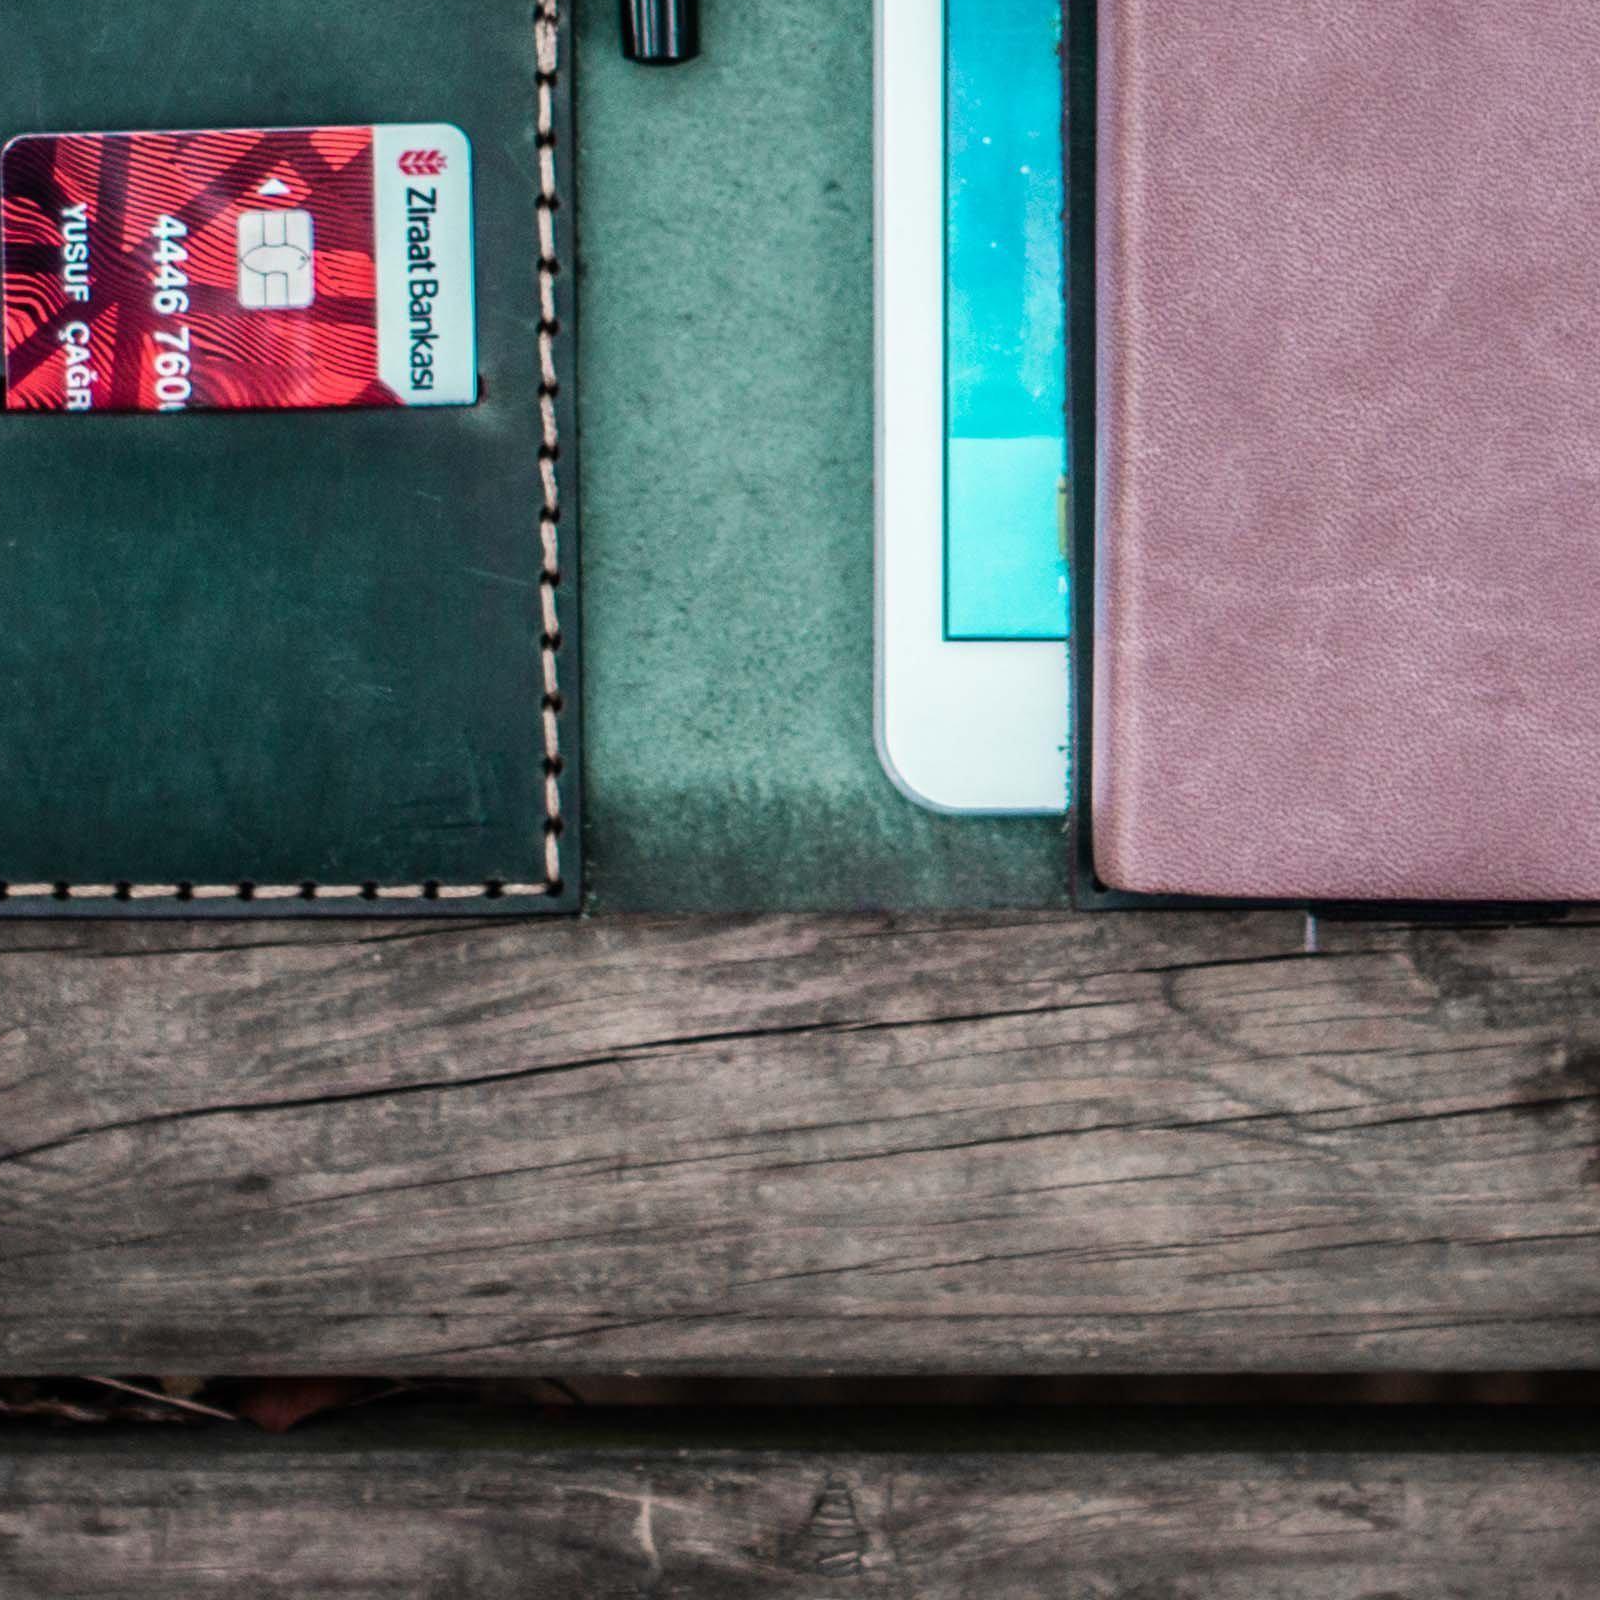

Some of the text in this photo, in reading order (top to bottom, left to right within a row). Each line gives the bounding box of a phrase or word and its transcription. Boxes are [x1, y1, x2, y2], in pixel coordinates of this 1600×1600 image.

[58, 203, 99, 410] YUSUF ÇAĞR
[151, 213, 190, 315] 4446
[406, 187, 439, 391] Ziraat Bankası
